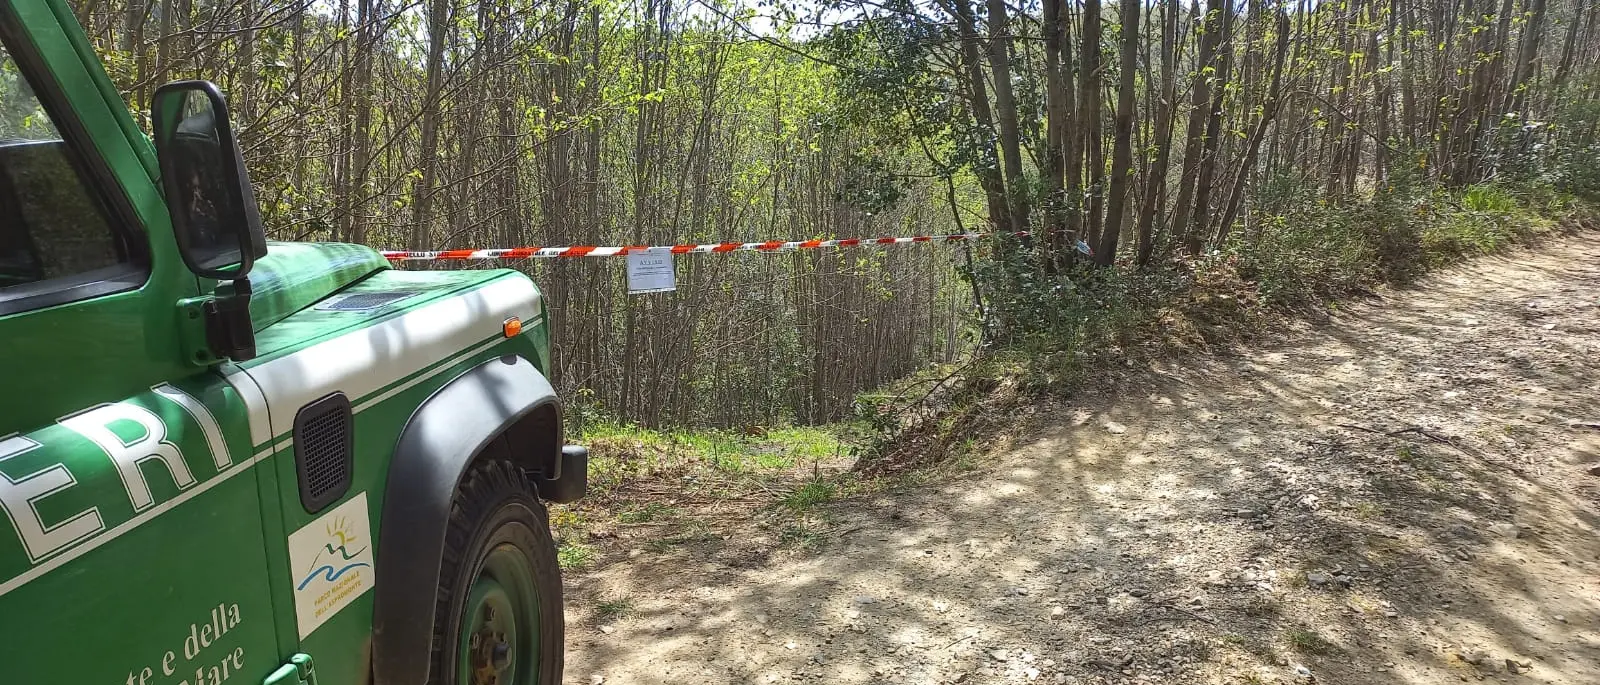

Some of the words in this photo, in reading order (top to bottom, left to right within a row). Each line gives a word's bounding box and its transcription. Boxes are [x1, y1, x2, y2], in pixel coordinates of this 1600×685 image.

[314, 590, 331, 606] PARCO
[331, 570, 360, 594] NAZIONALE
[314, 580, 362, 618] DELL'ASPROMONTE
[162, 650, 177, 676] e
[184, 602, 242, 661] della
